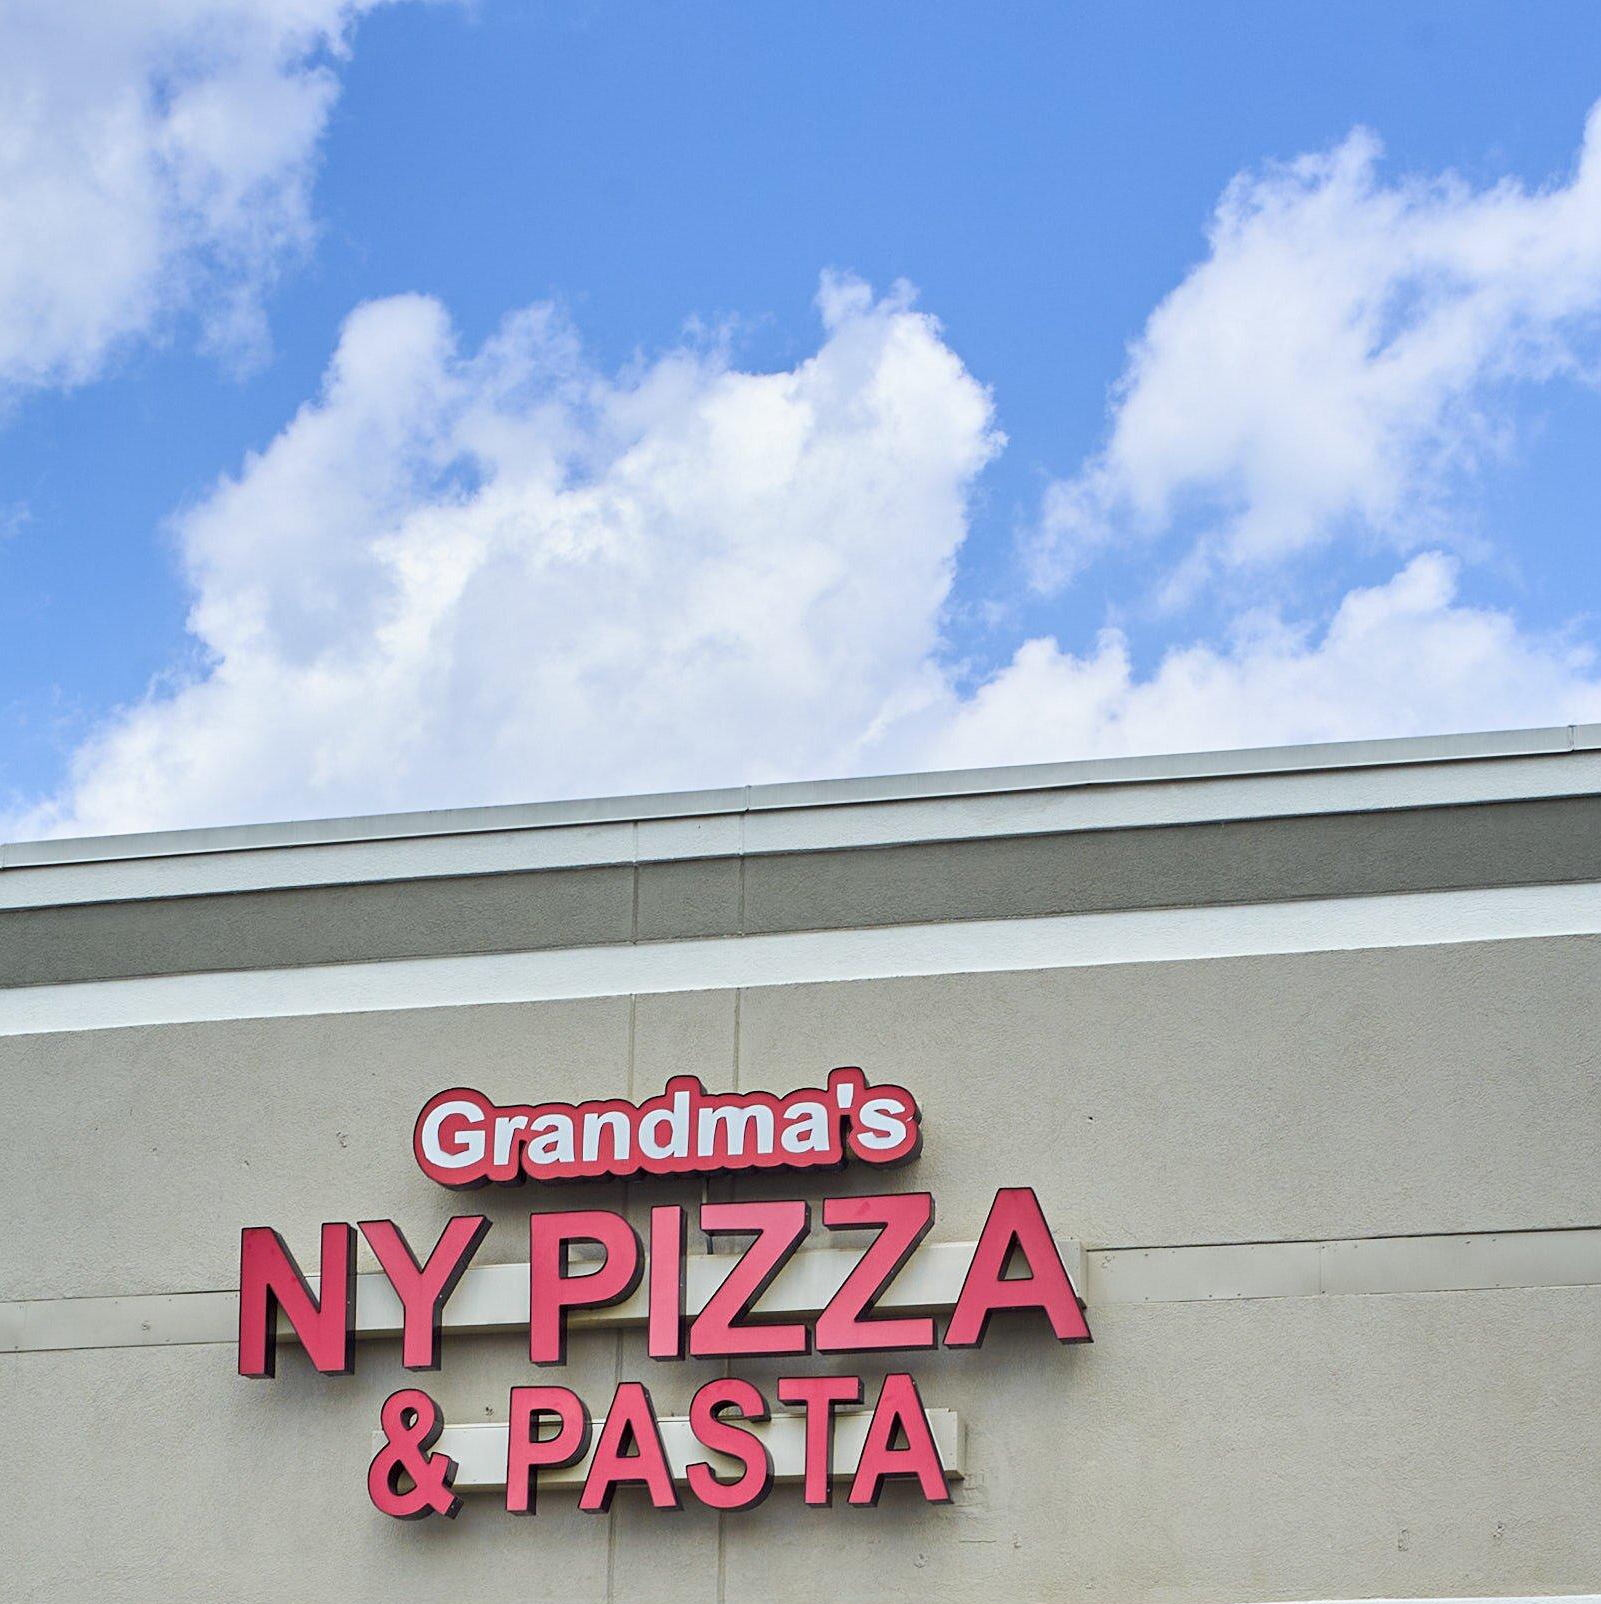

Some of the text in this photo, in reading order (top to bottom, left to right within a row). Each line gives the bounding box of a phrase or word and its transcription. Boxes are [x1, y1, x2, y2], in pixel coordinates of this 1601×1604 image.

[420, 1081, 910, 1169] Grandma's
[237, 1187, 1094, 1380] NY PIZZA
[367, 1373, 956, 1519] & PASTA
